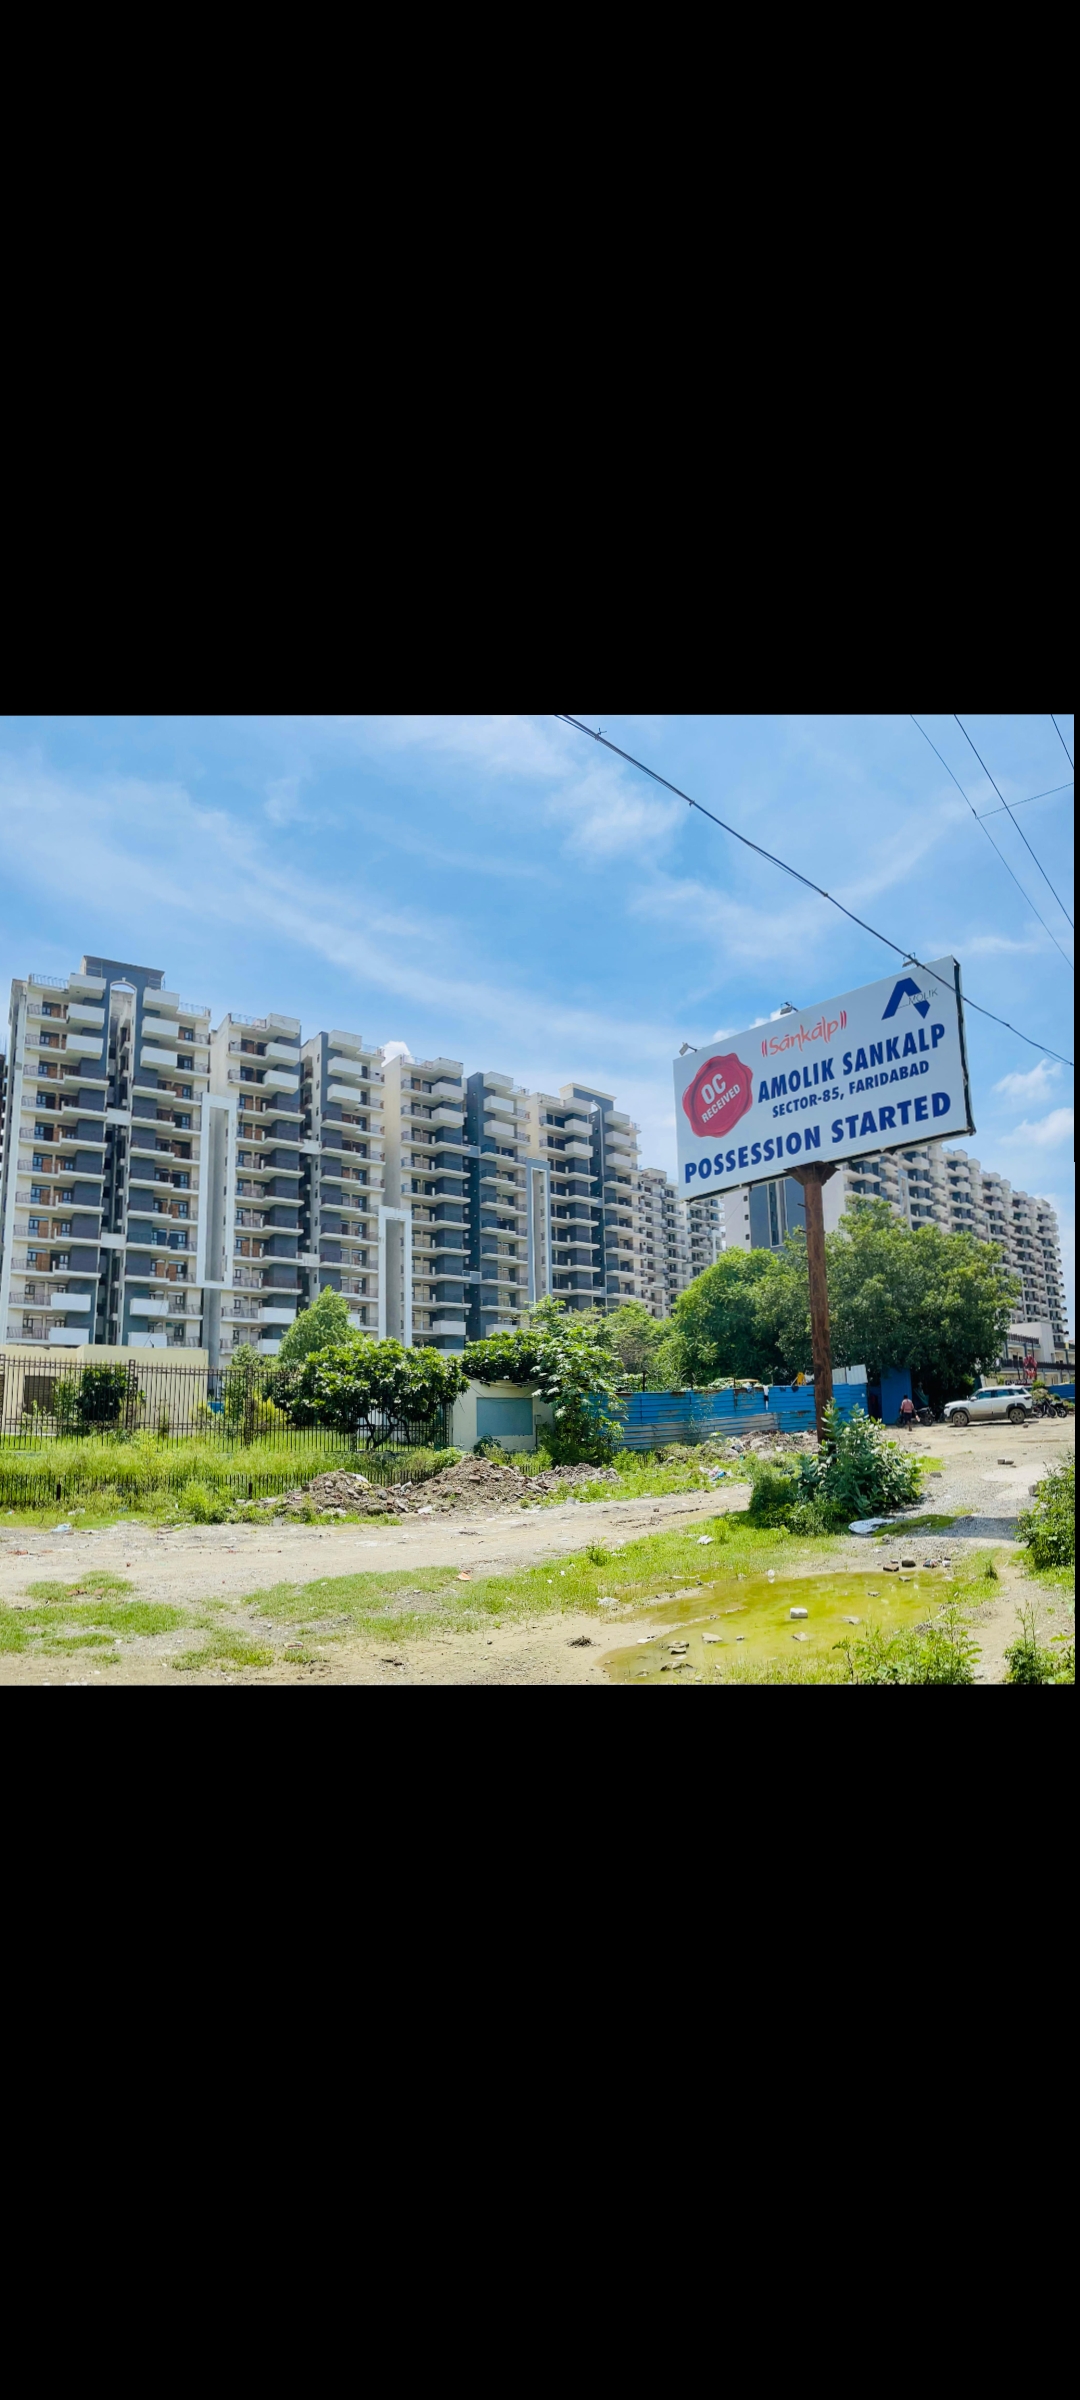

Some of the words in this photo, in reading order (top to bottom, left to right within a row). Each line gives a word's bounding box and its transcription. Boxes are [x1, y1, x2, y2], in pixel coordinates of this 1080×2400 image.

[701, 1074, 727, 1104] OC
[758, 1058, 834, 1103] AMOLIK
[843, 1023, 945, 1075] SANKALP
[772, 1090, 844, 1118] SECTOR-85,
[849, 1060, 930, 1094] FARIDABAD
[702, 1084, 741, 1123] RECEIVED
[685, 1125, 820, 1183] POSSESSION
[832, 1092, 951, 1143] STARTED
